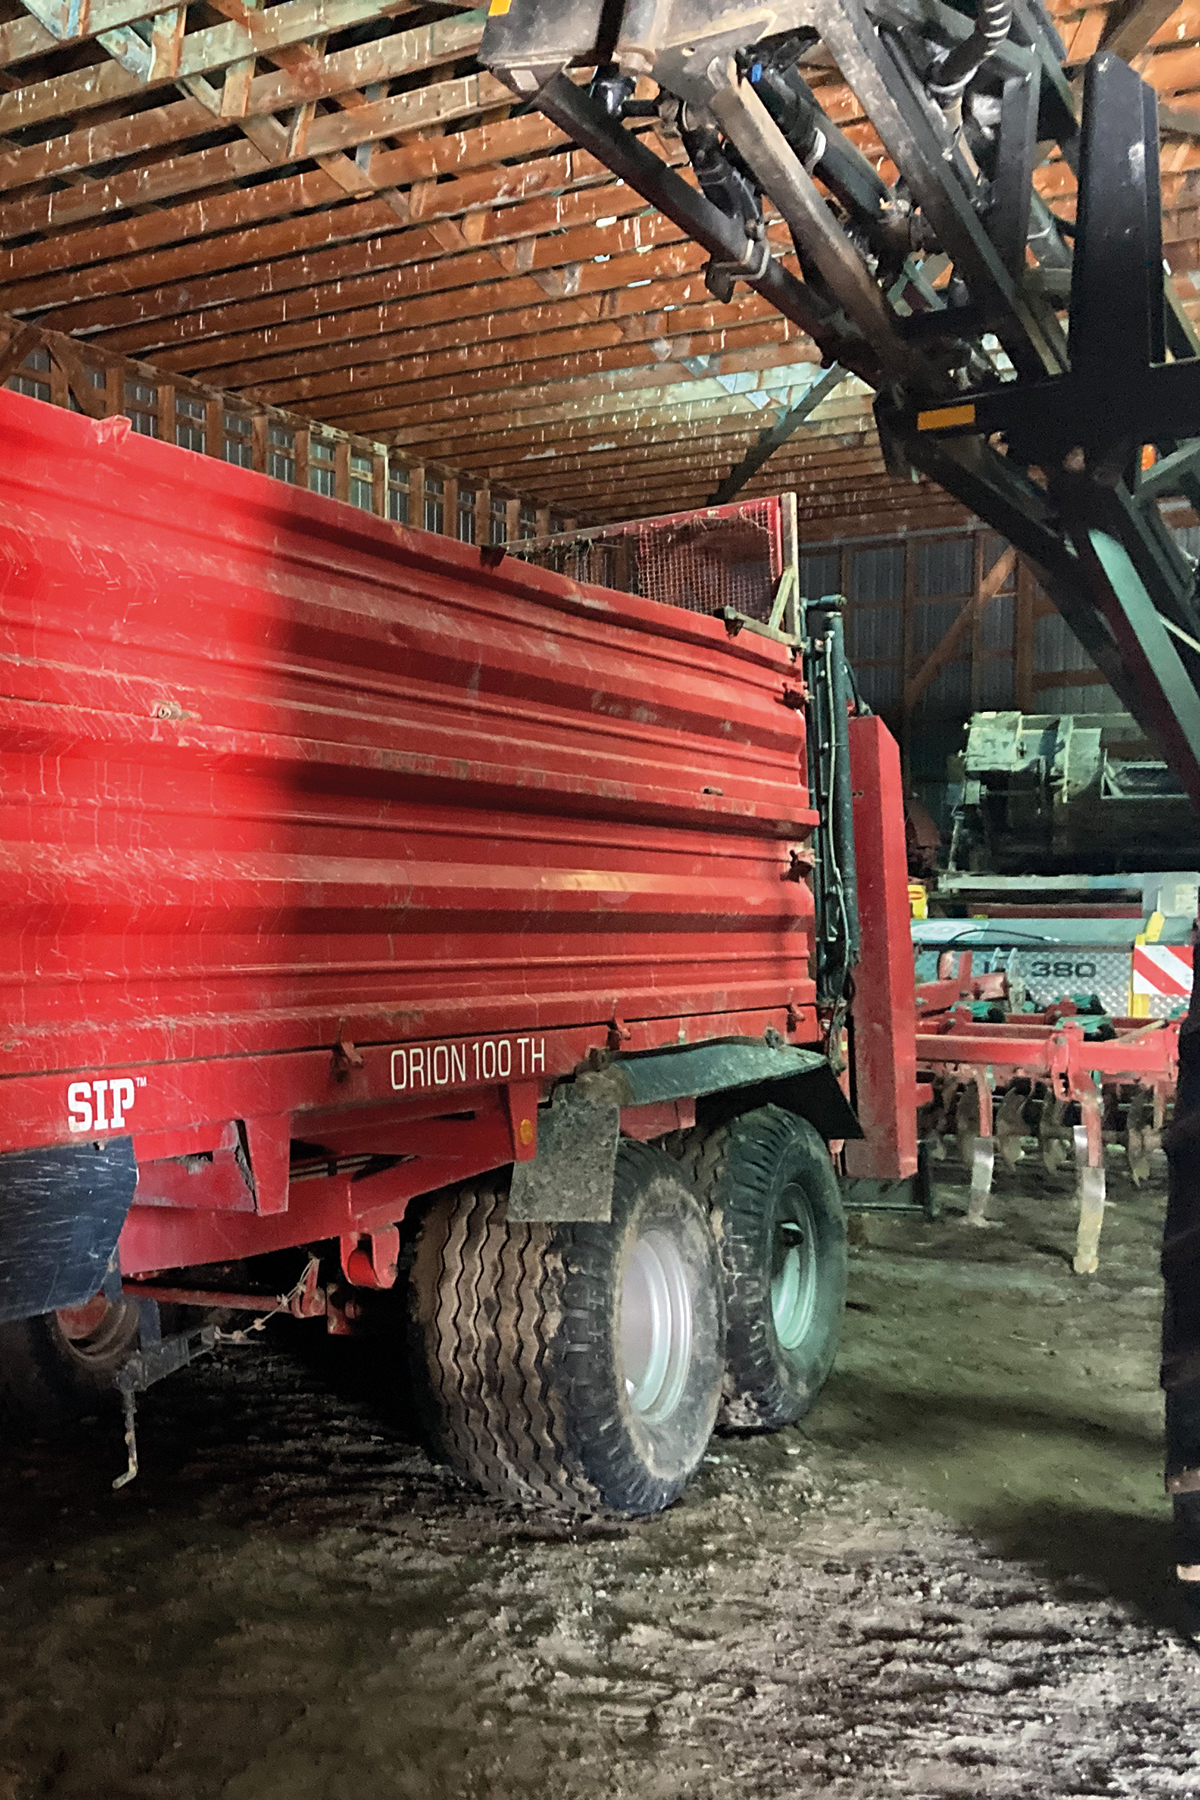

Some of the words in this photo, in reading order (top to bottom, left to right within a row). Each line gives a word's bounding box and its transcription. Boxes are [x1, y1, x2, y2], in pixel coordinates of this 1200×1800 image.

[1030, 961, 1097, 977] 380
[390, 1043, 466, 1090] ORION
[472, 1039, 512, 1080] 100
[516, 1037, 545, 1075] TH
